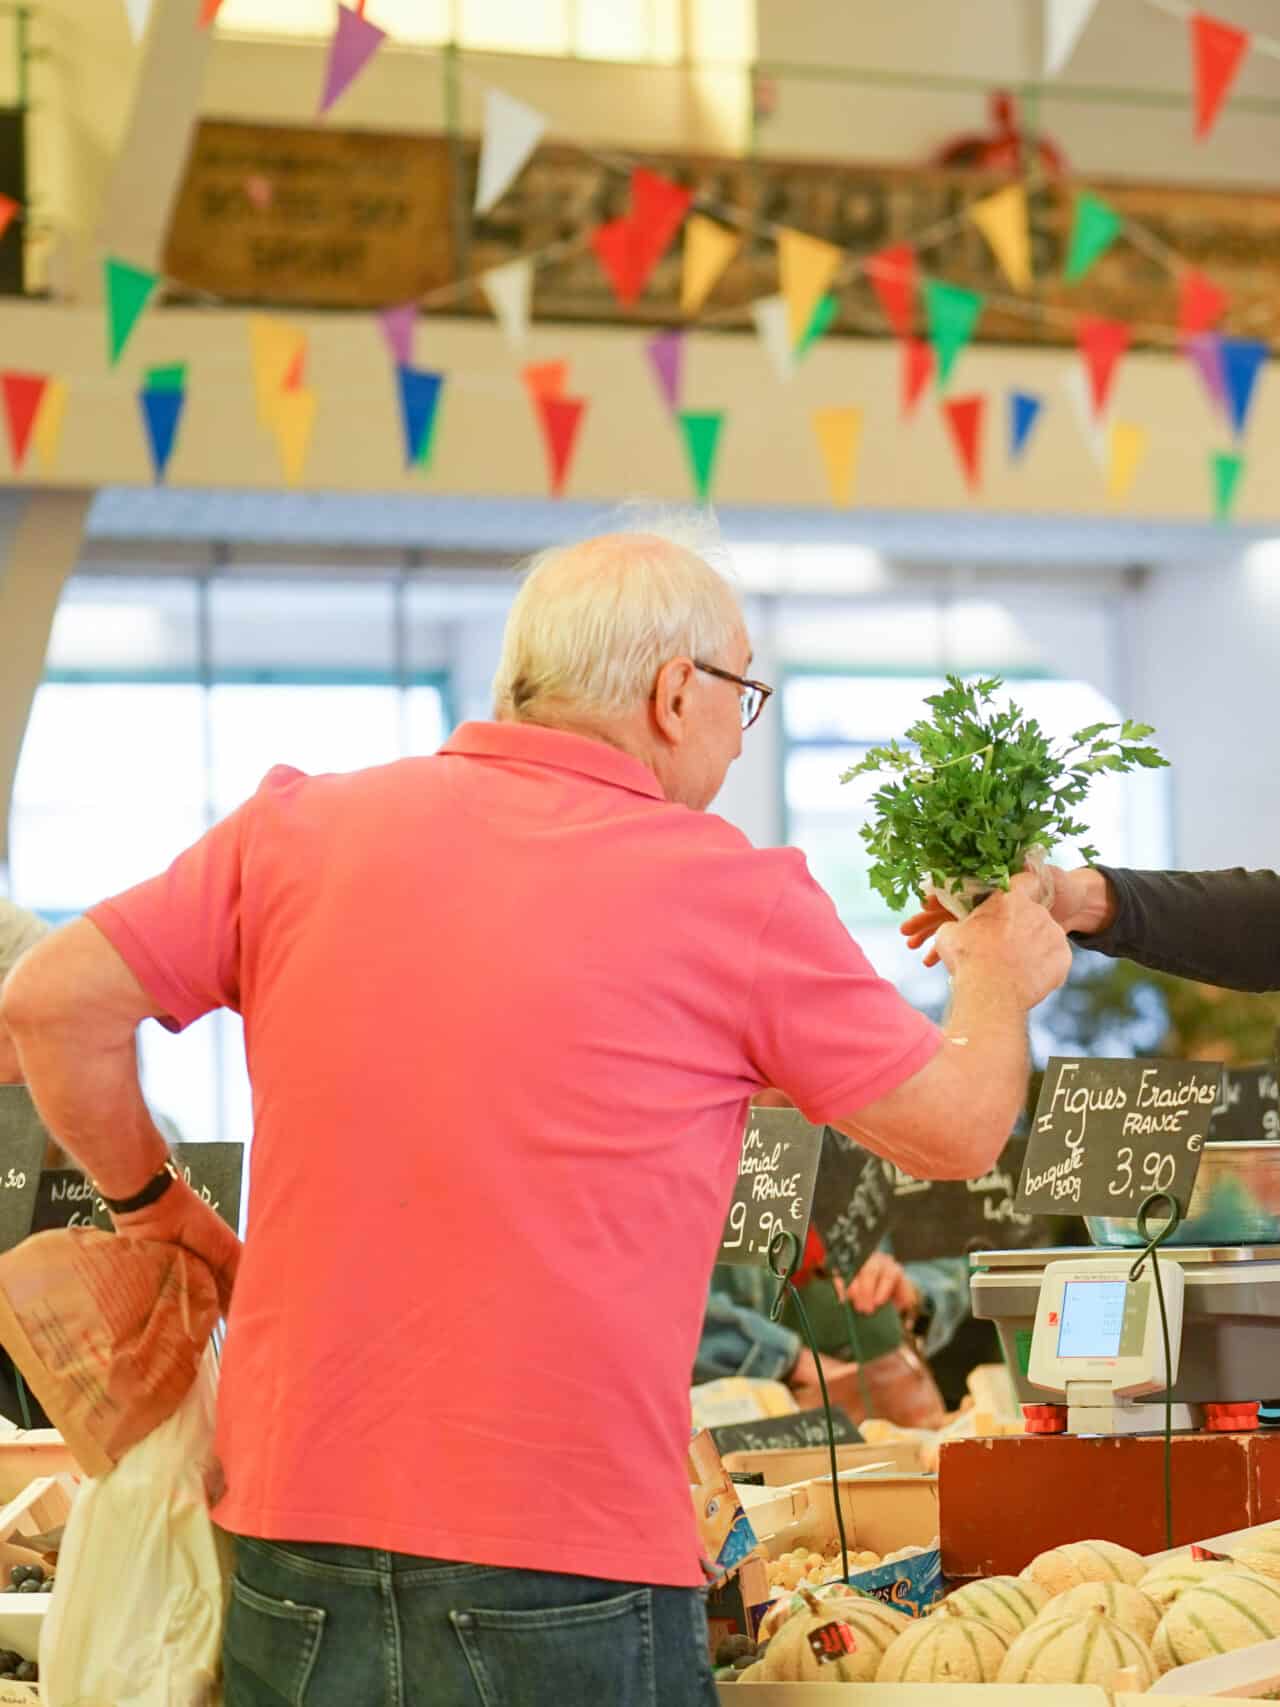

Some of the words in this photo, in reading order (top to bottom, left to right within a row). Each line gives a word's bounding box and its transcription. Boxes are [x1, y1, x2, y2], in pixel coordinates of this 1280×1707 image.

[1050, 1064, 1127, 1148] Figues
[1122, 1110, 1189, 1136] FRANCE
[752, 1173, 801, 1202] FRANCE
